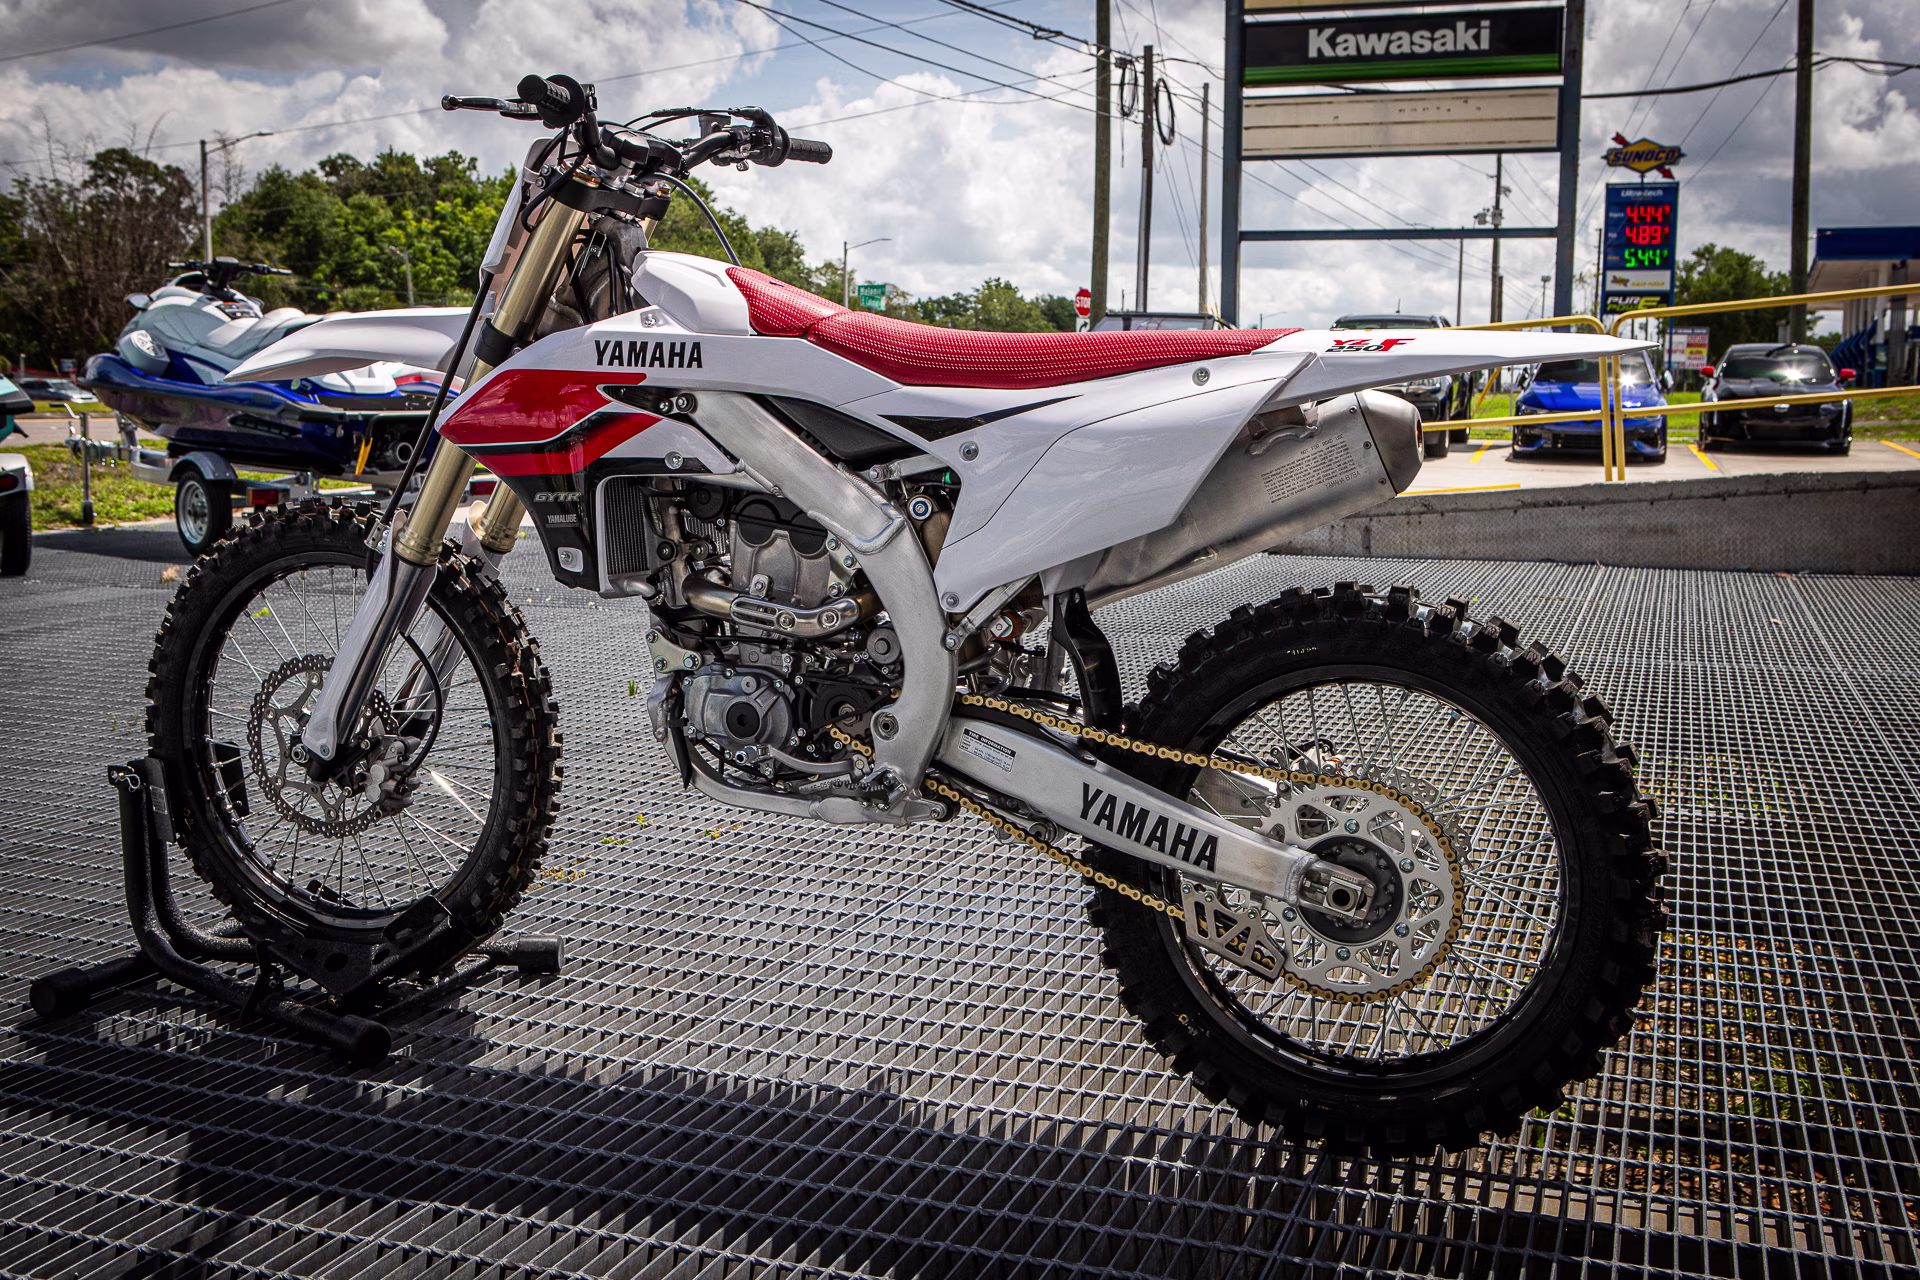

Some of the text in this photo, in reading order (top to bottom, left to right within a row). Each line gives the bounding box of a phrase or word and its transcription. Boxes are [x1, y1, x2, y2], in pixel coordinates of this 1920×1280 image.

[1308, 20, 1490, 58] Kawasaki
[1612, 149, 1677, 163] SUNOCO
[594, 340, 703, 368] YAMAHA
[1324, 477, 1344, 490] YAMAHA
[533, 491, 582, 503] GYTR
[547, 514, 578, 524] YAMALUBE
[980, 737, 1012, 755] INFORMATION
[1080, 782, 1219, 873] YAMAHA
